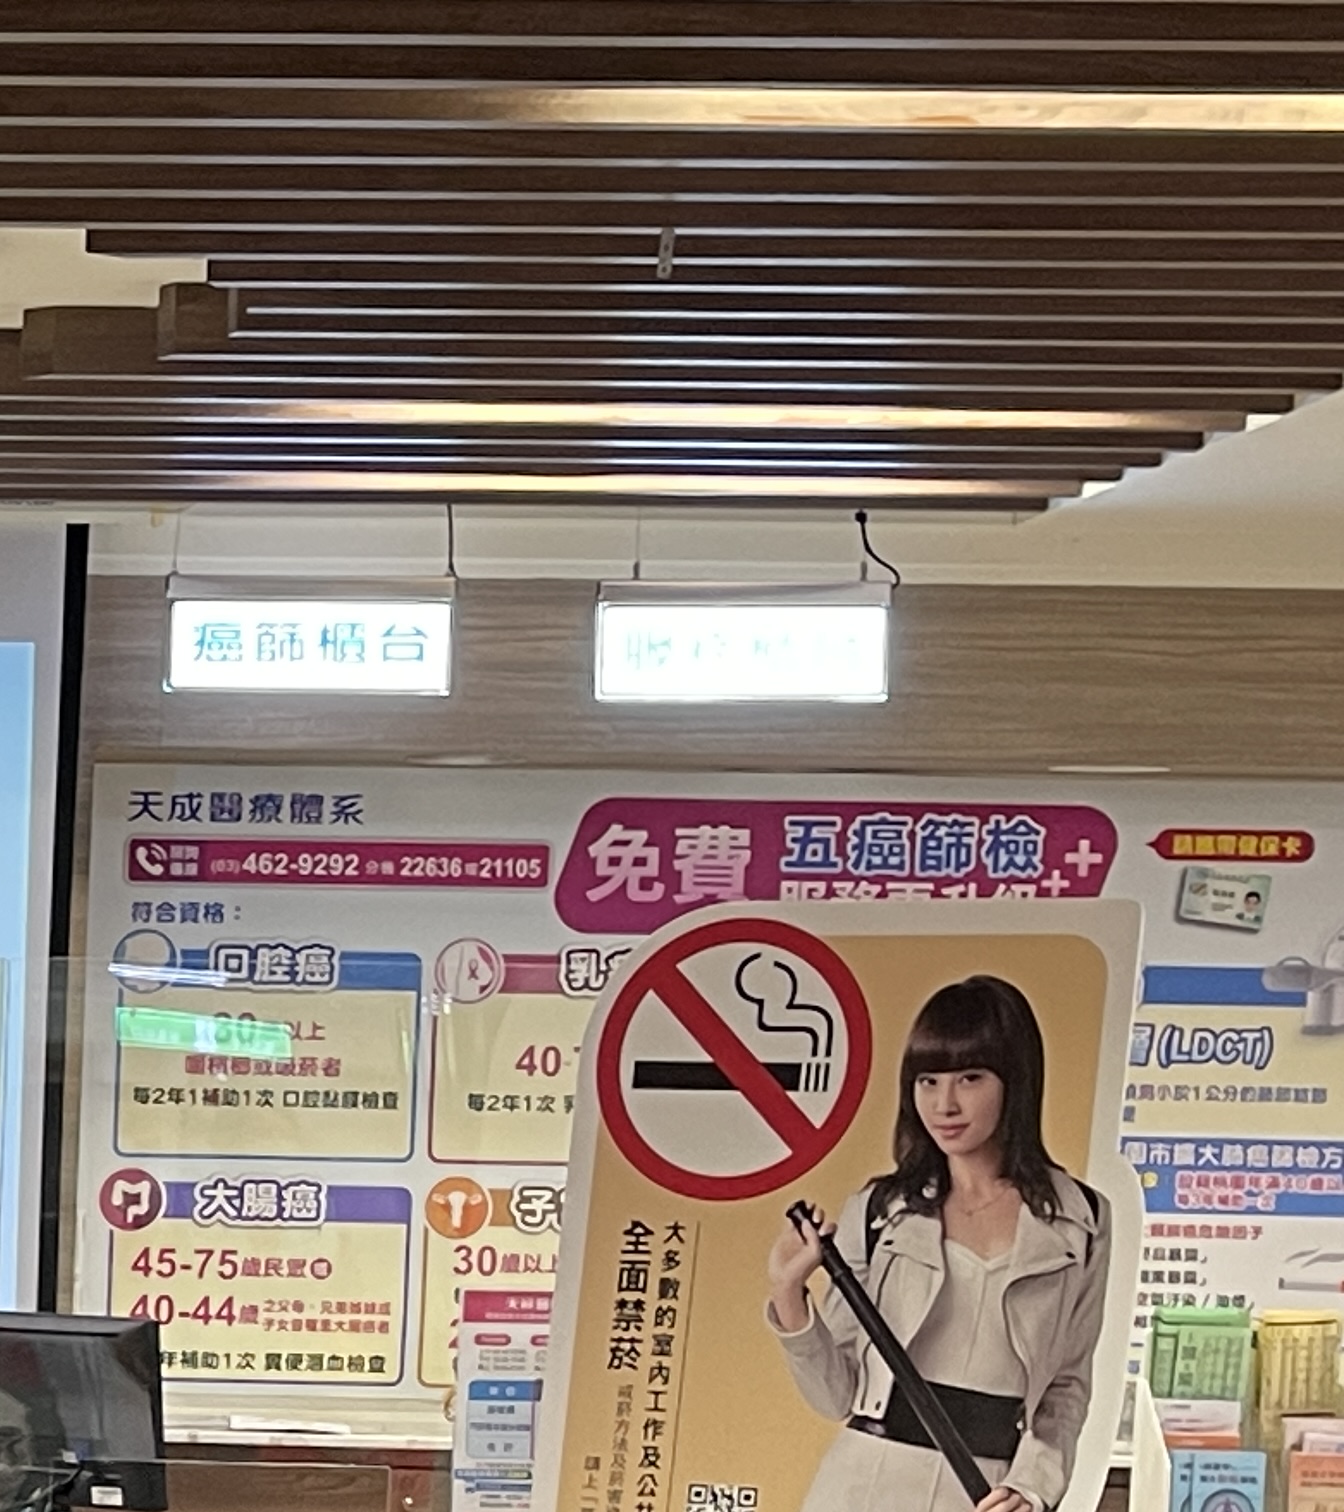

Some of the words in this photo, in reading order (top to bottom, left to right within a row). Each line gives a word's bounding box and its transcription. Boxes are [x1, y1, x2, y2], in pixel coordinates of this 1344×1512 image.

[193, 621, 429, 665] 癌篩櫃台
[127, 790, 365, 826] 天成醫療體系
[585, 820, 752, 905] 免費
[780, 813, 1045, 879] 五癌篩檢
[214, 943, 335, 987] 口腔癌
[514, 1045, 581, 1078] 40-
[196, 1180, 324, 1226] 大腸癌
[130, 1247, 307, 1281] 45-75歲民眾
[128, 1295, 259, 1327] 40-44歲
[607, 1219, 656, 1372] 全面禁菸
